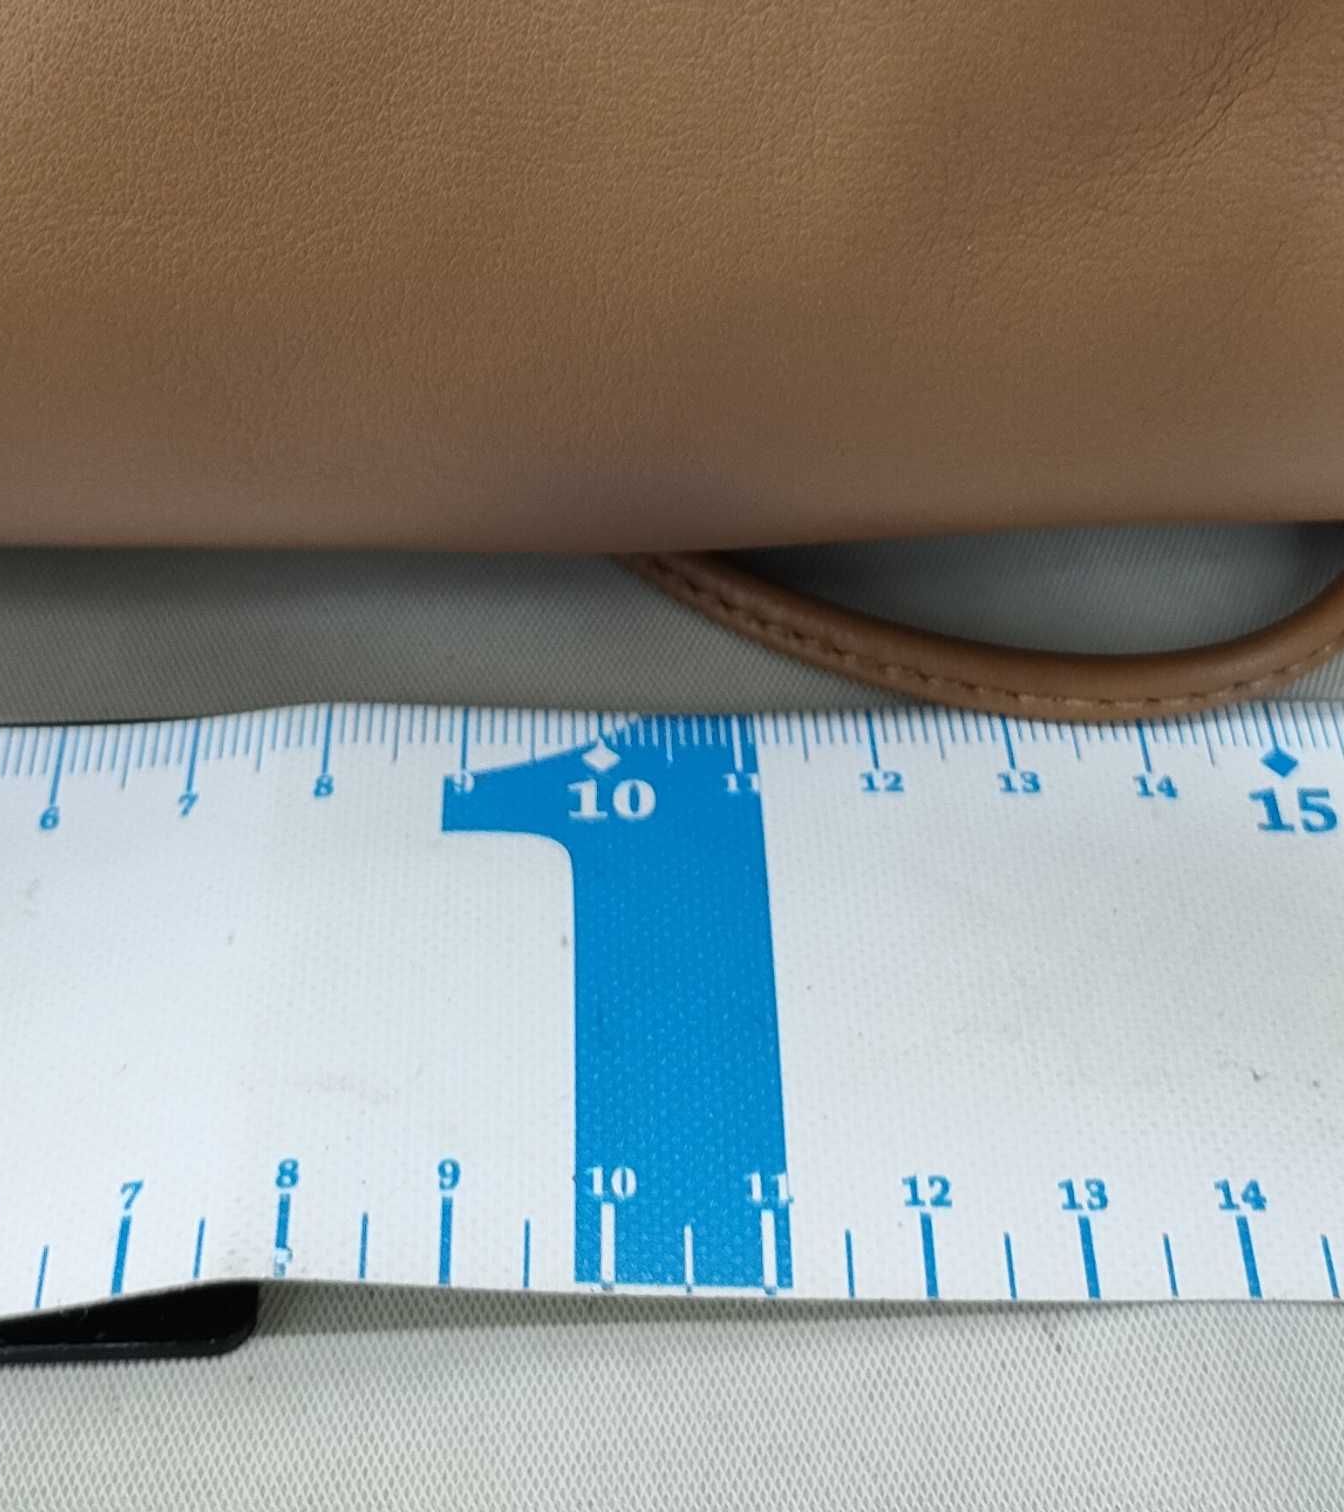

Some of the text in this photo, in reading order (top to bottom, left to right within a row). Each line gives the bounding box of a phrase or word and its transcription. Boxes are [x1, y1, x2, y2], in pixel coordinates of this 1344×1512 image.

[39, 806, 61, 830] 6
[178, 793, 199, 817] 7
[313, 775, 334, 798] 8
[452, 771, 475, 795] 9
[567, 779, 657, 821] 10
[722, 772, 761, 794] 11
[860, 771, 904, 794] 12
[999, 771, 1041, 795] 13
[1133, 774, 1178, 800] 14
[1249, 787, 1338, 835] 15
[442, 713, 793, 1288] 1
[120, 1180, 143, 1211] 7
[275, 1159, 299, 1189] 8
[437, 1159, 461, 1190] 9
[586, 1166, 637, 1200] 10
[743, 1171, 794, 1203] 11
[902, 1175, 953, 1209] 12
[1057, 1178, 1109, 1212] 13
[1214, 1178, 1268, 1212] 14
